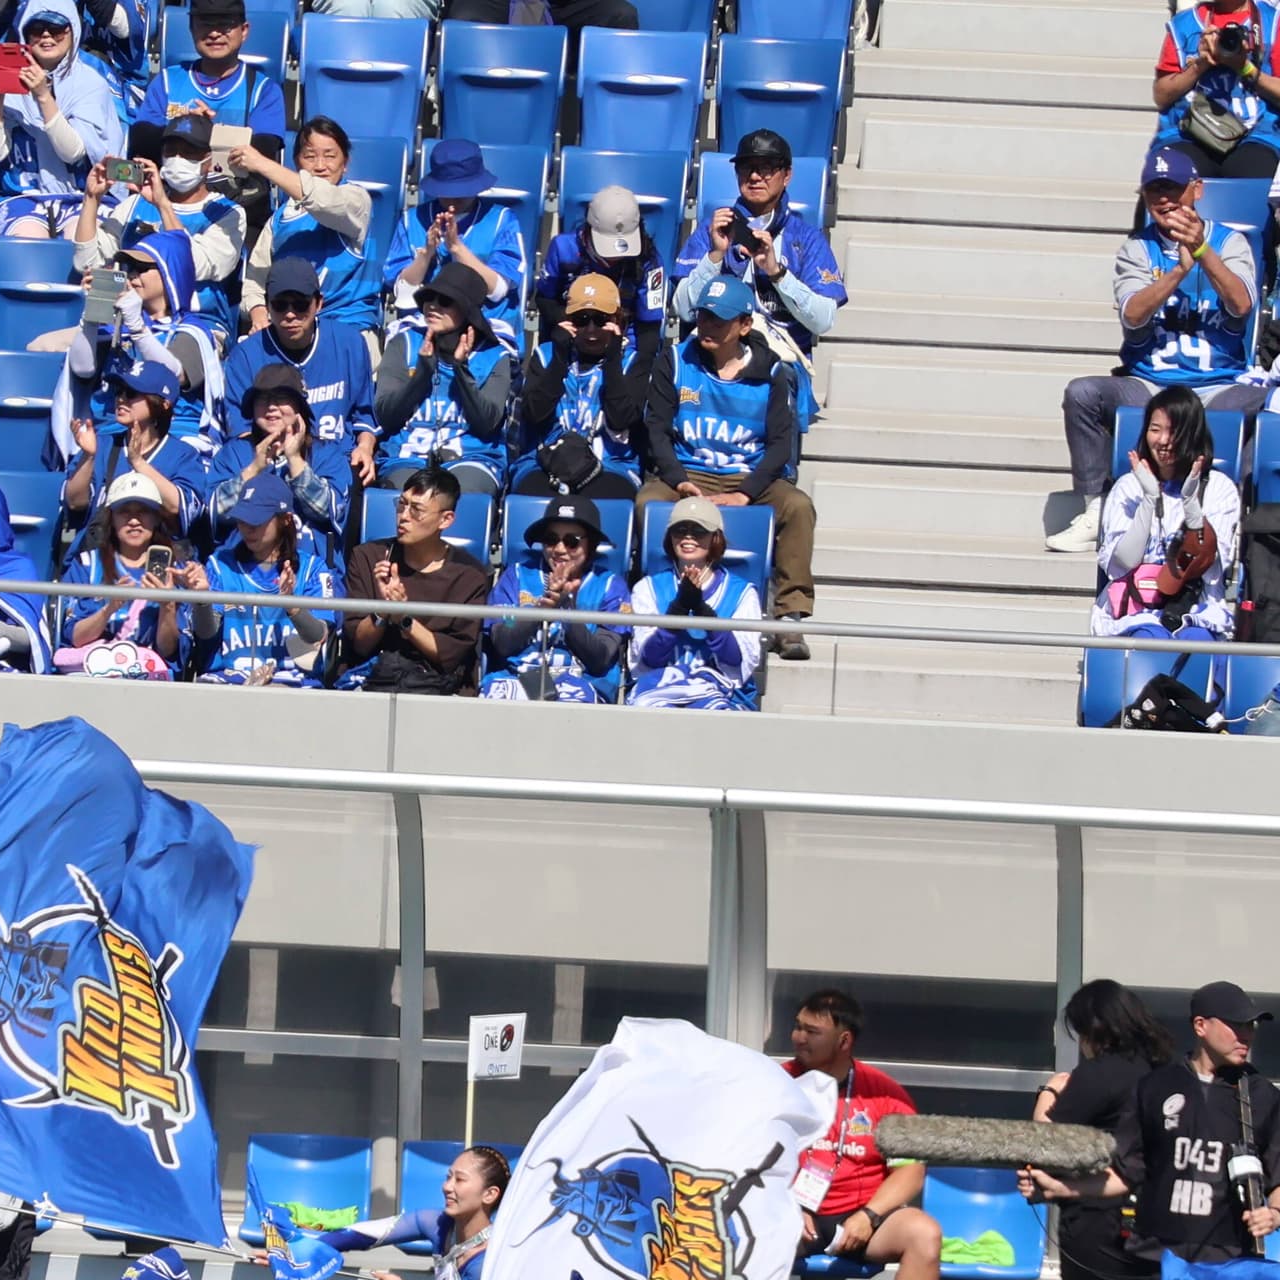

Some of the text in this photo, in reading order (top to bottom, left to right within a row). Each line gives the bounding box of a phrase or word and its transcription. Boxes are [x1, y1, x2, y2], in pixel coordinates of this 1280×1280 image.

[319, 415, 345, 440] 24
[683, 416, 756, 453] AITAMA
[103, 928, 183, 1113] KNIGHTS
[64, 984, 126, 1115] WILD
[483, 1033, 499, 1051] ONE
[1173, 1137, 1224, 1172] 043
[1170, 1180, 1214, 1216] HB
